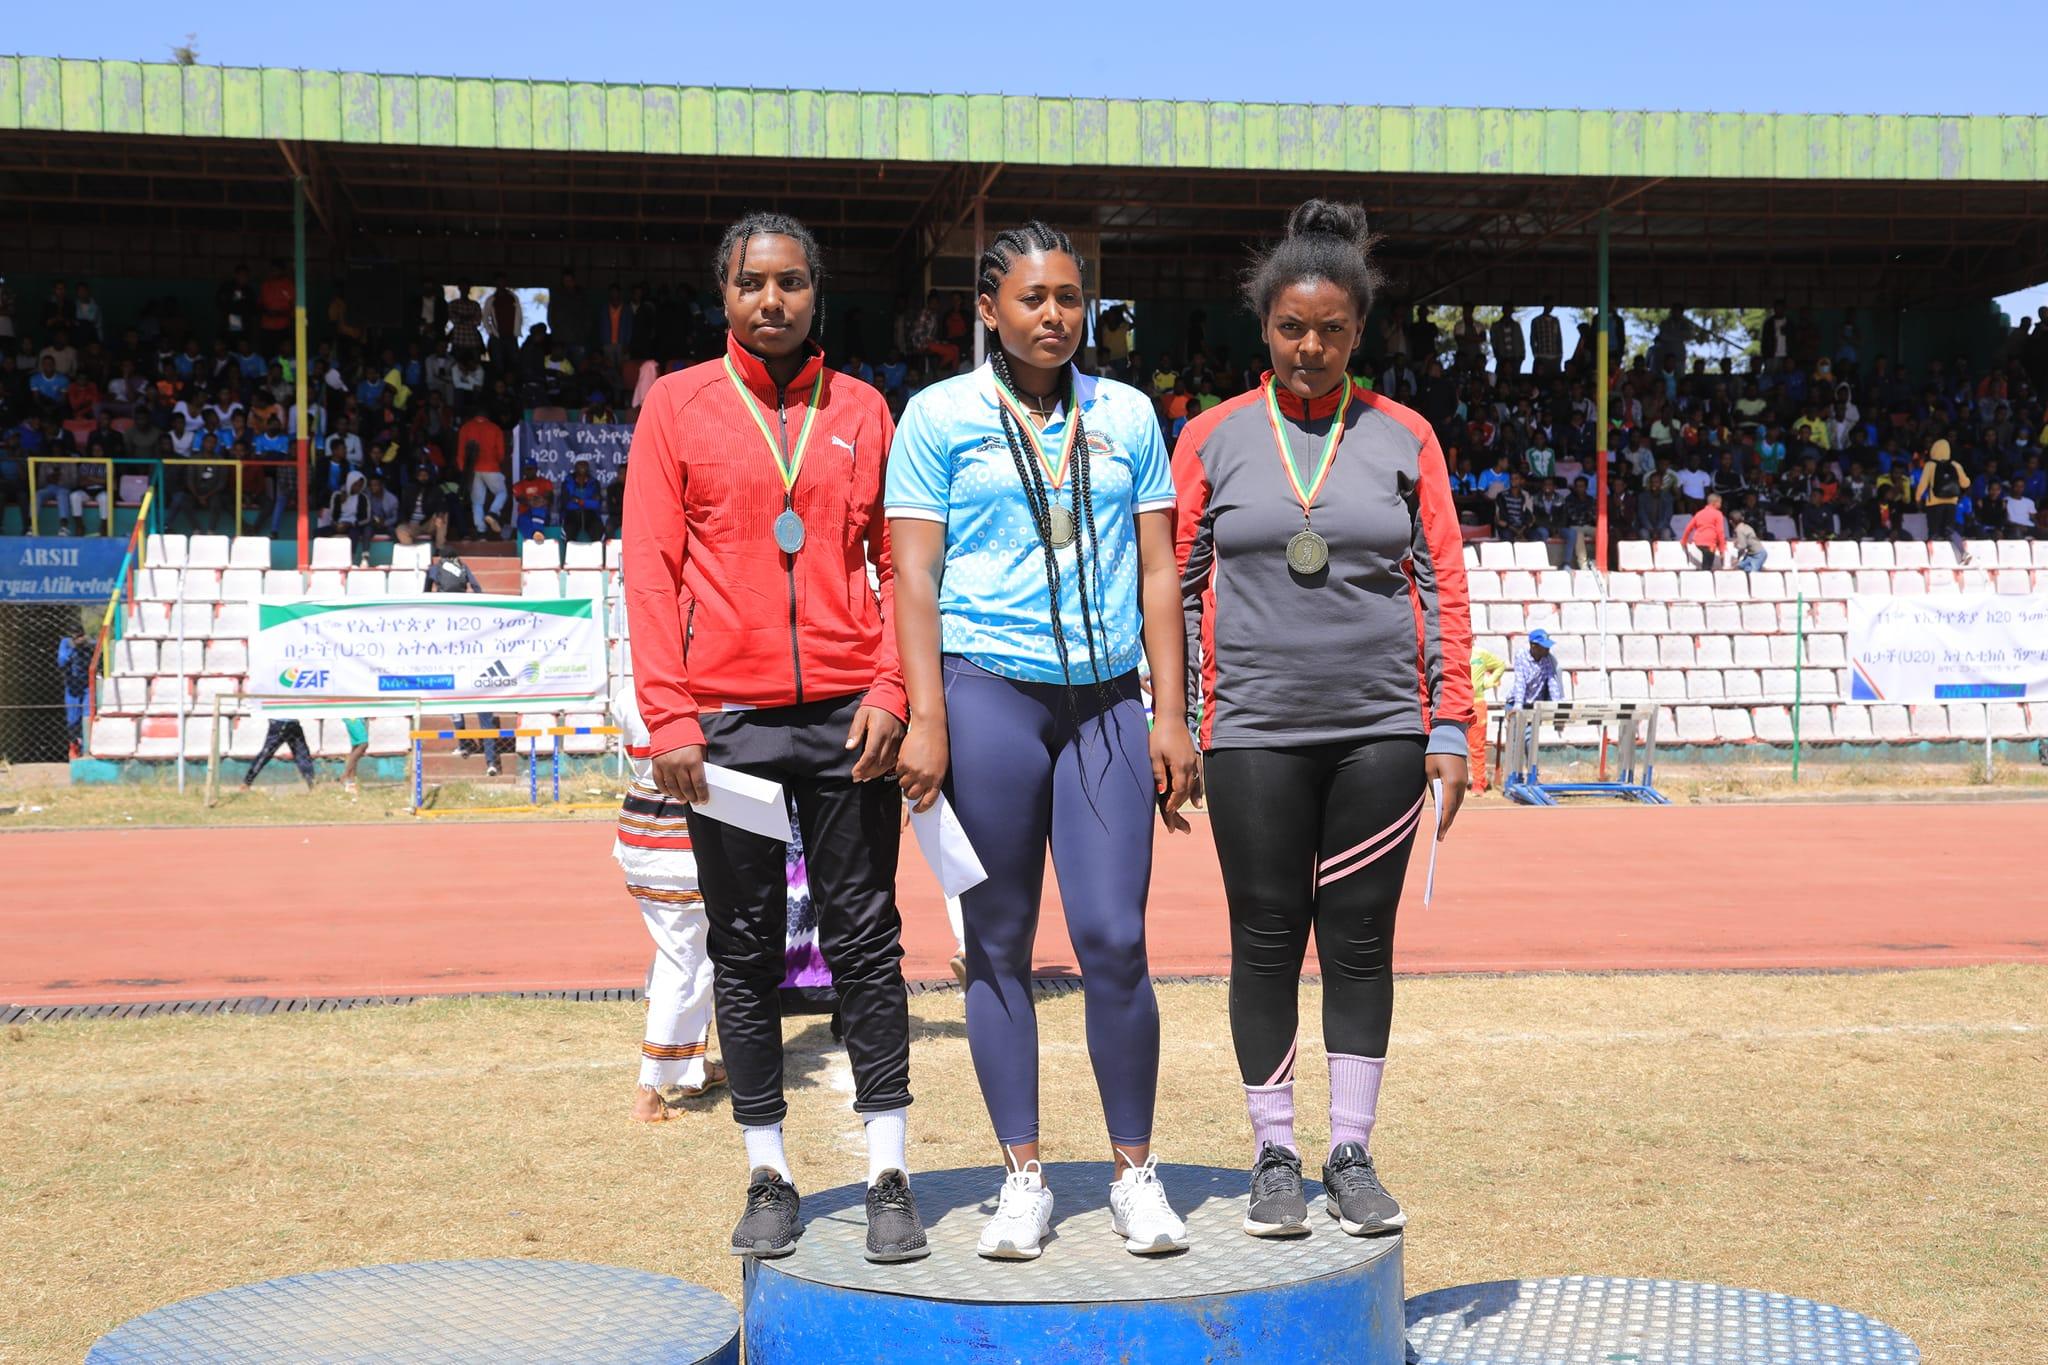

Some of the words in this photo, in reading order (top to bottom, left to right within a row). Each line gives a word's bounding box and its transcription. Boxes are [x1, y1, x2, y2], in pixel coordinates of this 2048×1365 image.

[576, 428, 633, 445] የኢትዮጵ
[2019, 611, 2048, 623] ዓመ
[294, 669, 330, 689] EAF
[473, 676, 518, 689] adidas
